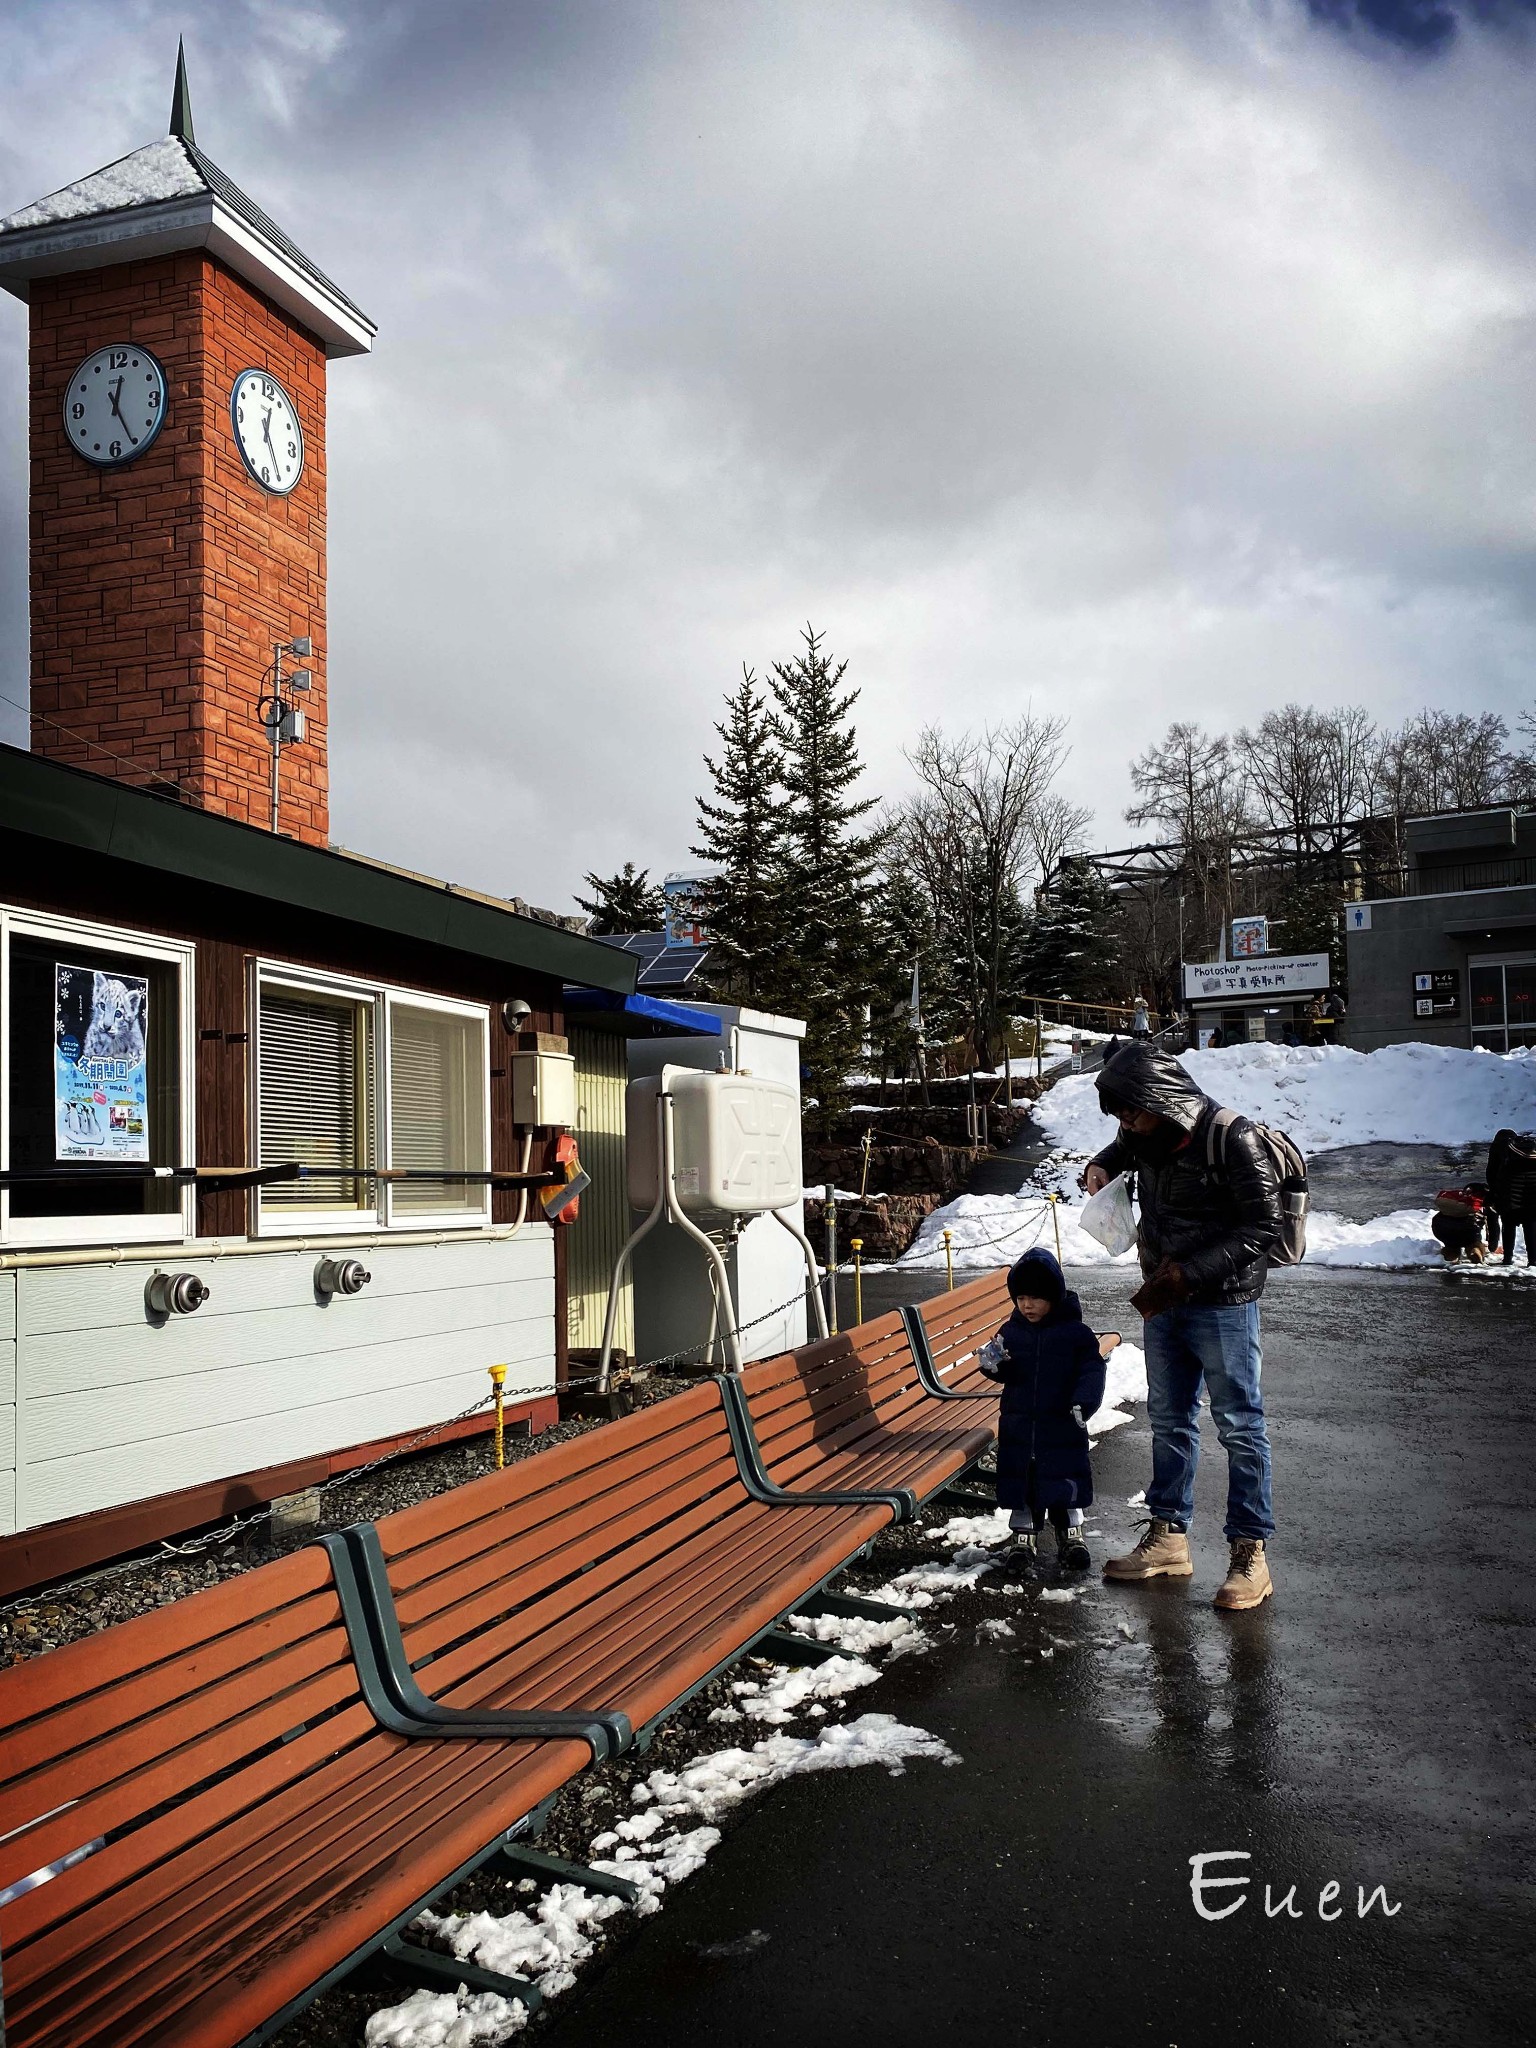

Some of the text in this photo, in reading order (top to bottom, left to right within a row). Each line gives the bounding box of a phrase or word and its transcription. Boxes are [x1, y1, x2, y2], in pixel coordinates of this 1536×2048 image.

[109, 352, 128, 370] 12
[148, 391, 160, 408] 3
[261, 380, 275, 402] 12
[72, 402, 85, 420] 9
[109, 440, 122, 458] 6
[287, 441, 297, 459] 3
[261, 466, 270, 484] 6
[1225, 974, 1286, 989] 写真受取所
[79, 1057, 127, 1080] 冬期開園
